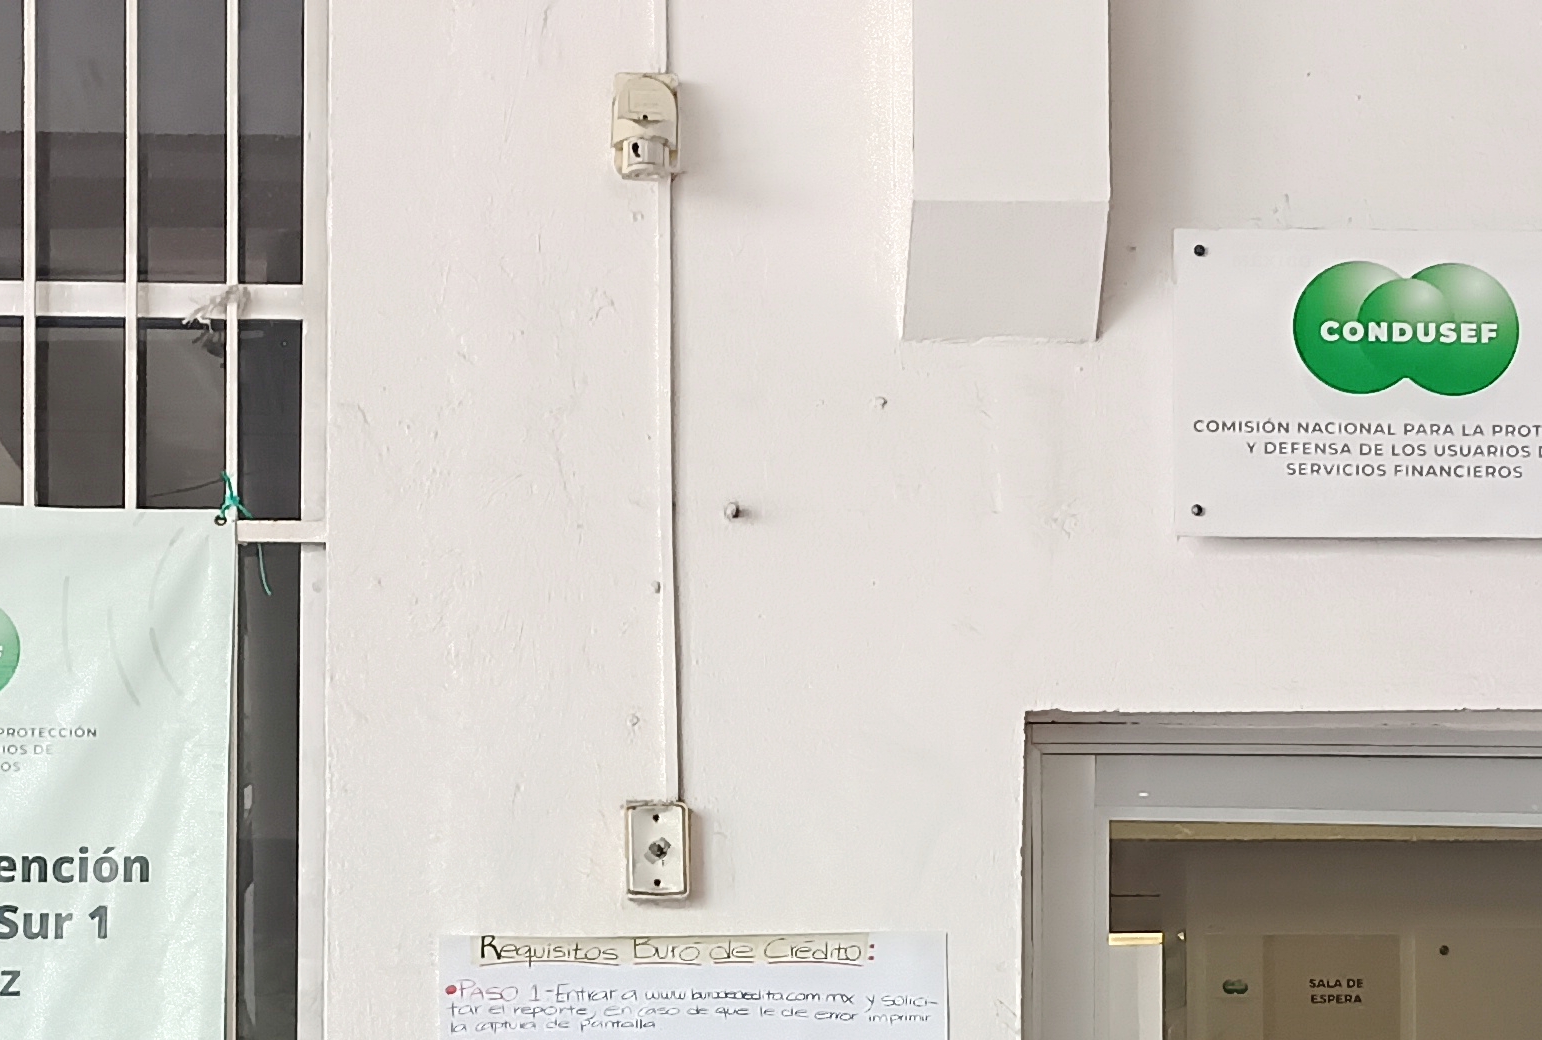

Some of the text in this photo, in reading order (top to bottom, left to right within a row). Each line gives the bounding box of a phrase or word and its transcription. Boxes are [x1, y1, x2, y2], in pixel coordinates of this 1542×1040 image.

[1320, 321, 1497, 344] CONDUSEF
[1193, 417, 1289, 434] COMISIÓN
[1297, 422, 1396, 436] NACIONAL
[1404, 423, 1454, 436] PARA
[1462, 424, 1484, 436] LA
[1247, 442, 1256, 454] Y
[1264, 442, 1351, 455] DEFENSA
[1359, 444, 1383, 456] DE
[1391, 444, 1427, 457] LOS
[1434, 444, 1531, 457] USUARIOS
[1287, 463, 1523, 478] SERVICIOS FINANCIEROS
[34, 744, 52, 755] DE
[88, 907, 109, 938] 1
[481, 935, 619, 966] Requisitos
[710, 940, 754, 960] de
[1309, 979, 1363, 988] SALA DE
[1311, 994, 1361, 1004] ESPERA
